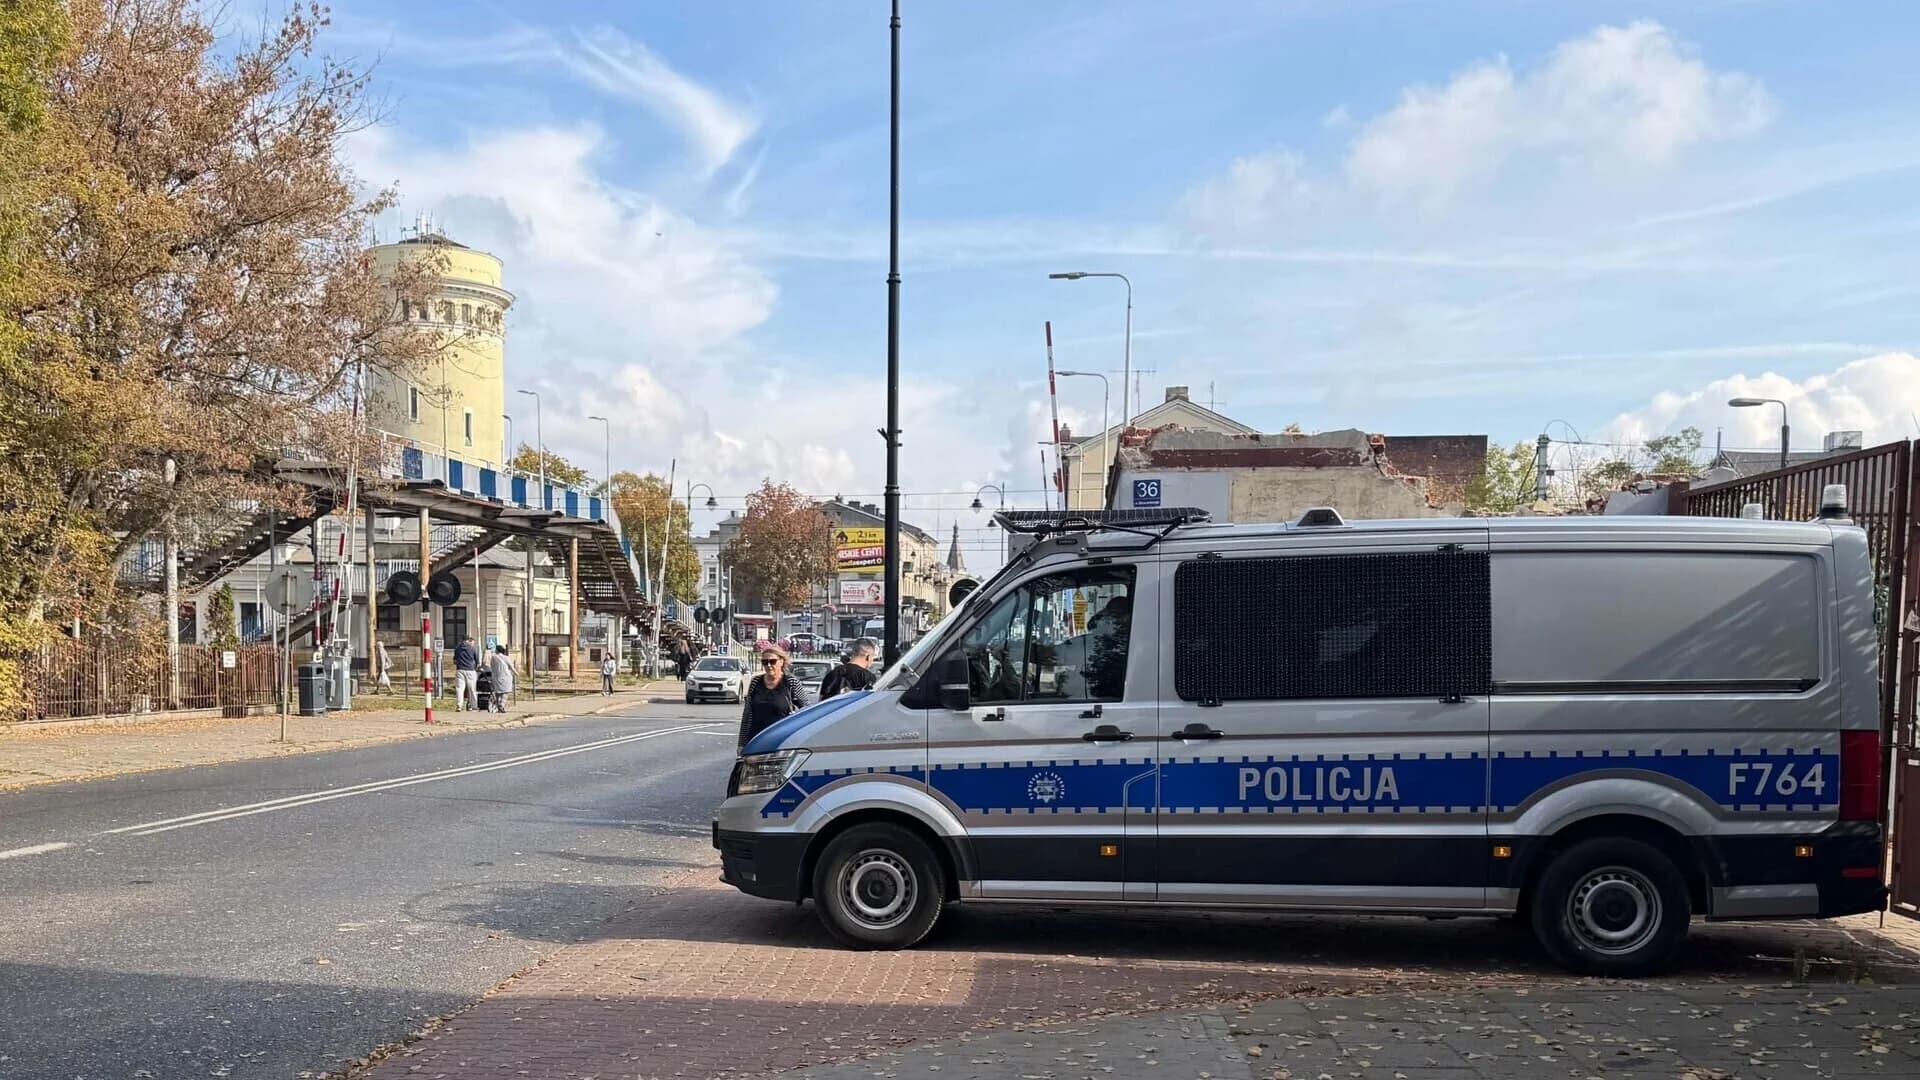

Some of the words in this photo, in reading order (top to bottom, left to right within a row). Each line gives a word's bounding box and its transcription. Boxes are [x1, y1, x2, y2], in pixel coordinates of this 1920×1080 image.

[1137, 481, 1159, 498] 36
[1239, 766, 1400, 801] POLICJA
[1729, 762, 1826, 796] F764
